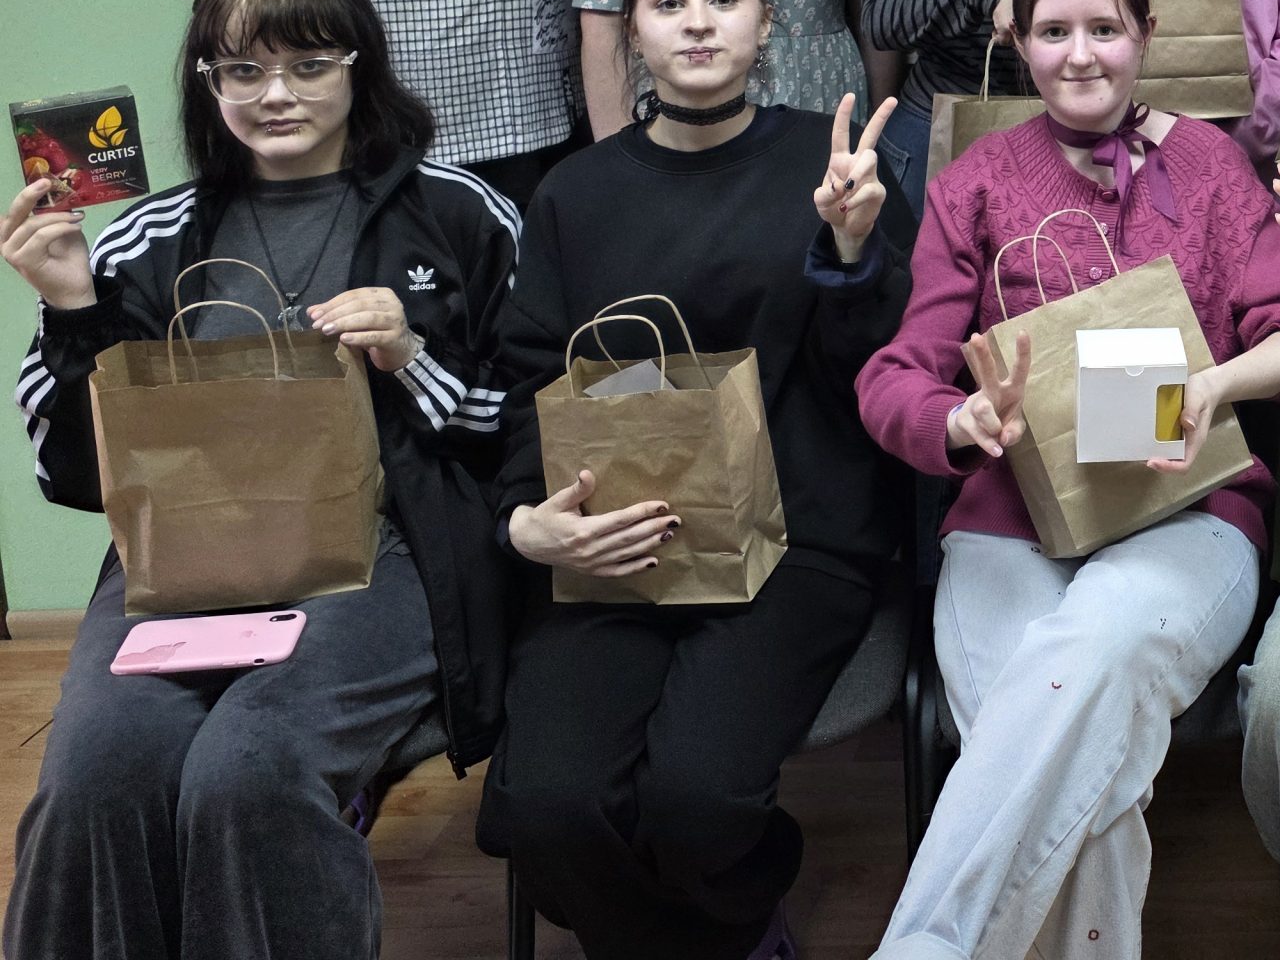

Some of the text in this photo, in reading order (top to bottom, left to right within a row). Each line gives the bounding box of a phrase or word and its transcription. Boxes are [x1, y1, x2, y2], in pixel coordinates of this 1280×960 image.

[88, 146, 136, 164] CURTIS
[90, 167, 108, 175] VERY
[91, 170, 127, 183] BERRY
[408, 282, 436, 291] adidas
